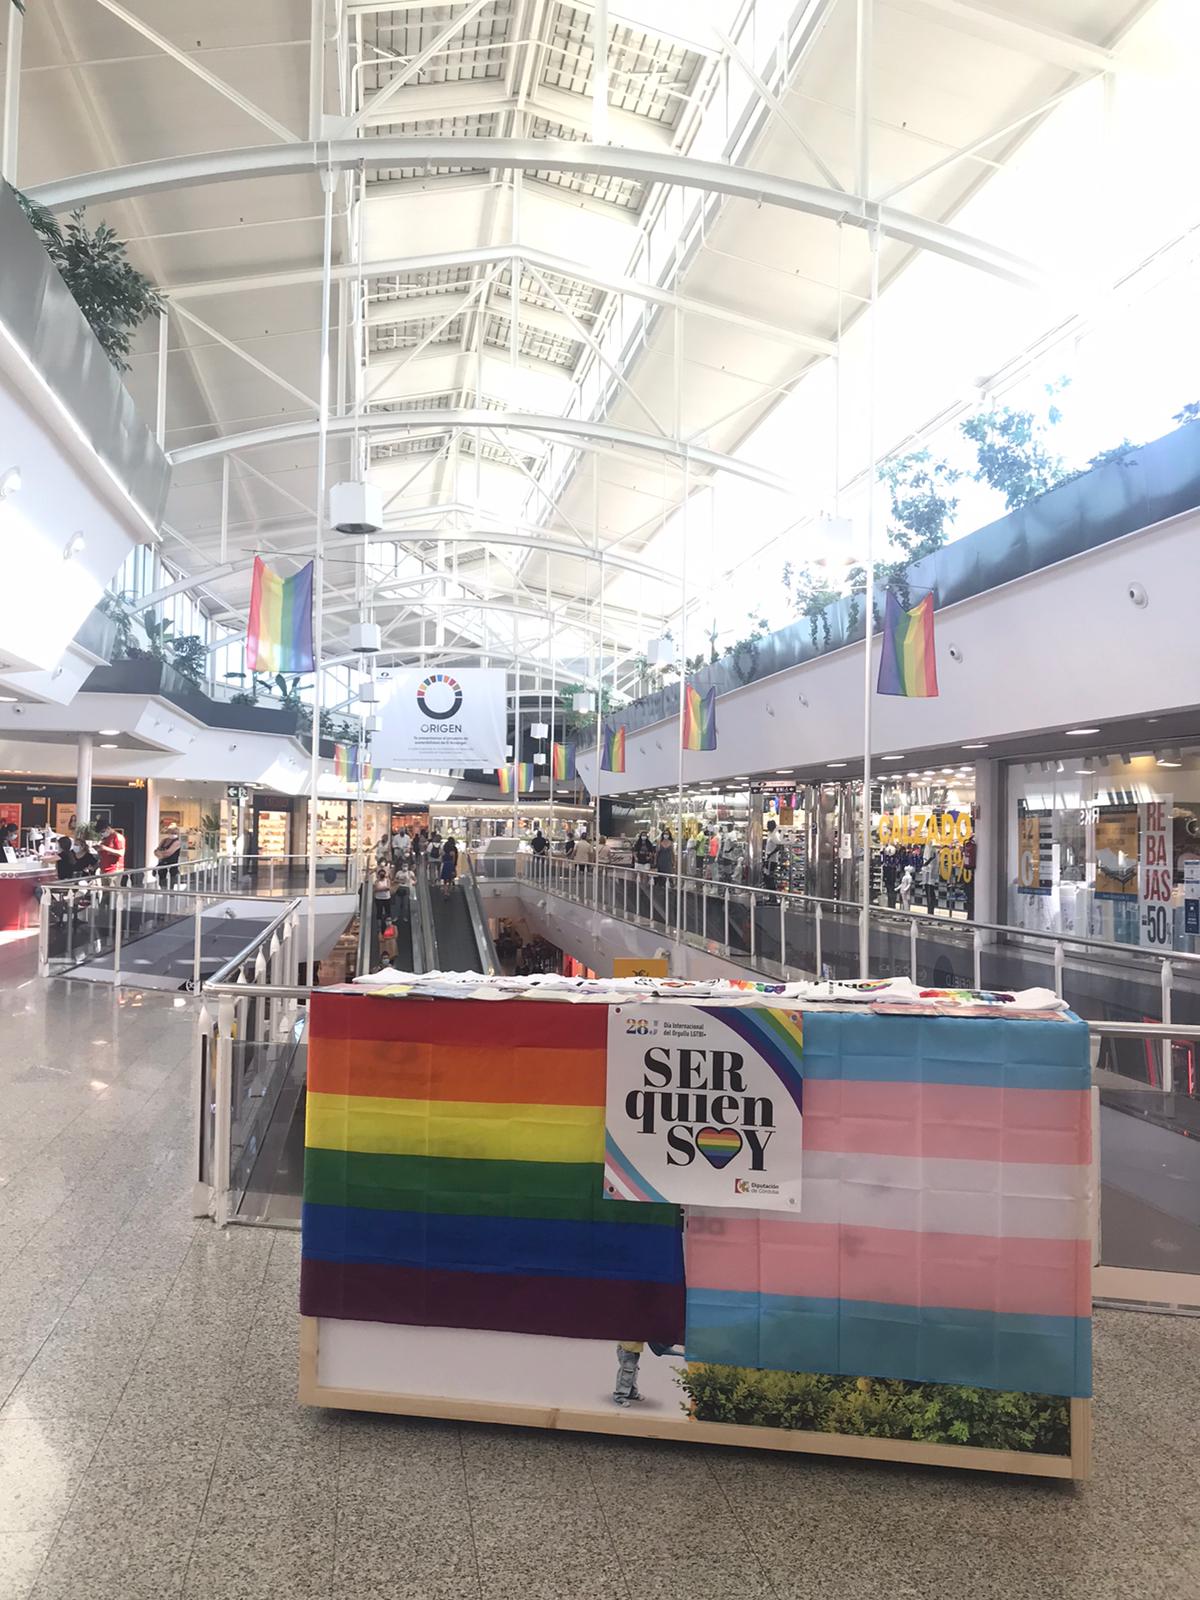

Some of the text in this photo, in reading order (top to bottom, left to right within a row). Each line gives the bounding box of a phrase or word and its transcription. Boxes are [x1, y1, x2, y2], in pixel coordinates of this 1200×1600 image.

[420, 723, 462, 733] ORIGEN
[878, 812, 972, 846] CALZADO
[1146, 835, 1167, 866] BA
[1143, 868, 1171, 903] JAS
[644, 1047, 748, 1092] SER
[625, 1089, 776, 1134] quien
